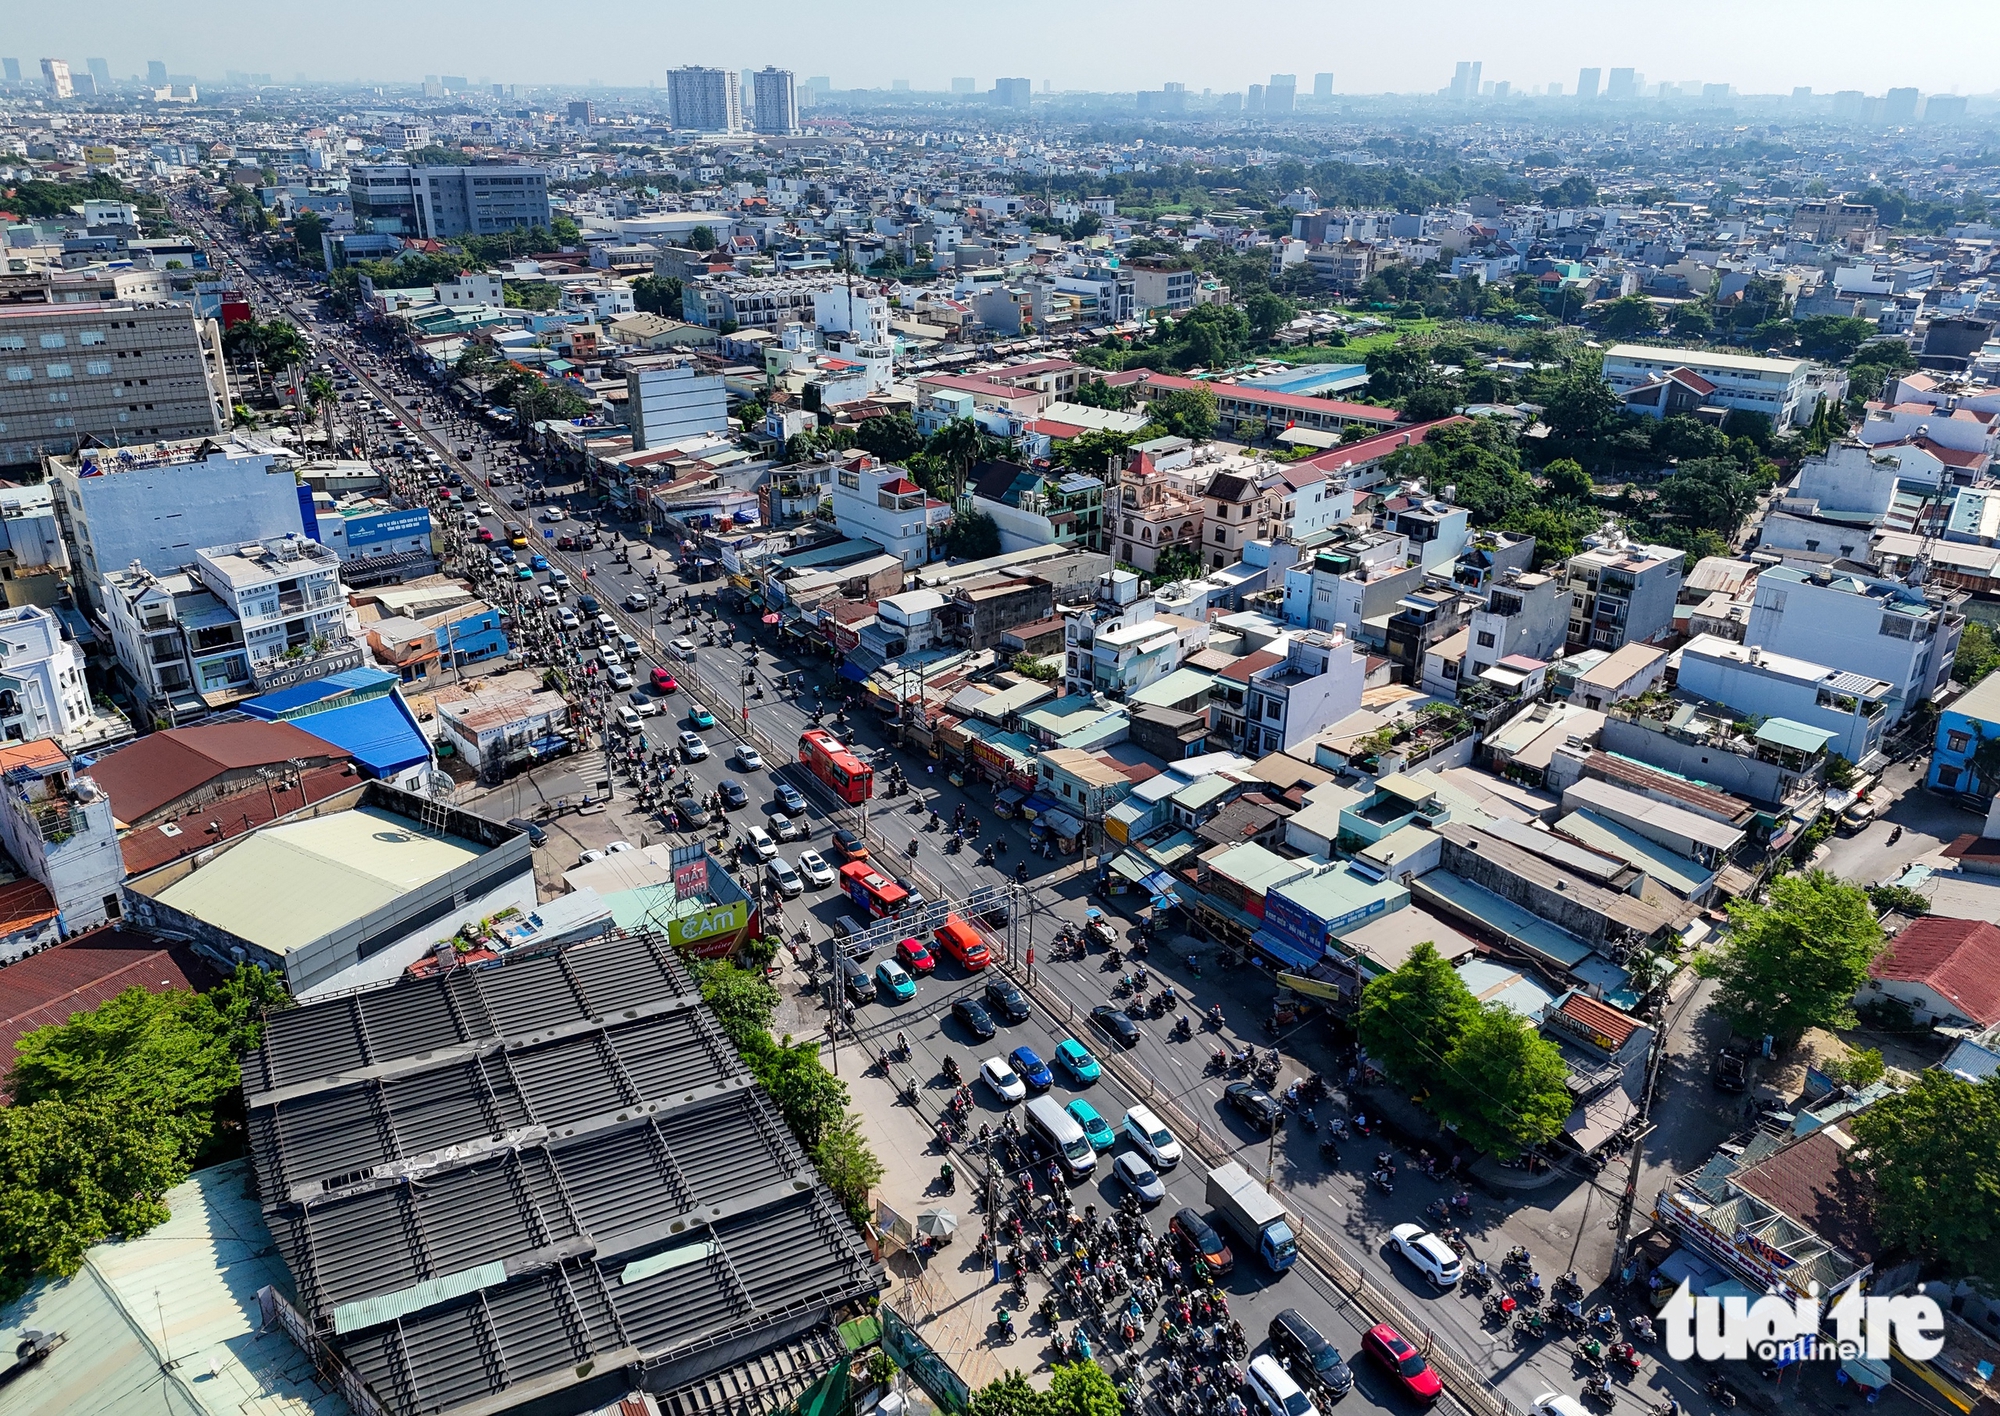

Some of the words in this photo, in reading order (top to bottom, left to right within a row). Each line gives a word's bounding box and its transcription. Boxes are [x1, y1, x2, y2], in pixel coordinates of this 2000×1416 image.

[679, 864, 704, 885] MẮT
[679, 881, 707, 899] KÍNH
[693, 940, 733, 956] Budweiser
[1752, 1236, 1790, 1268] Tiger
